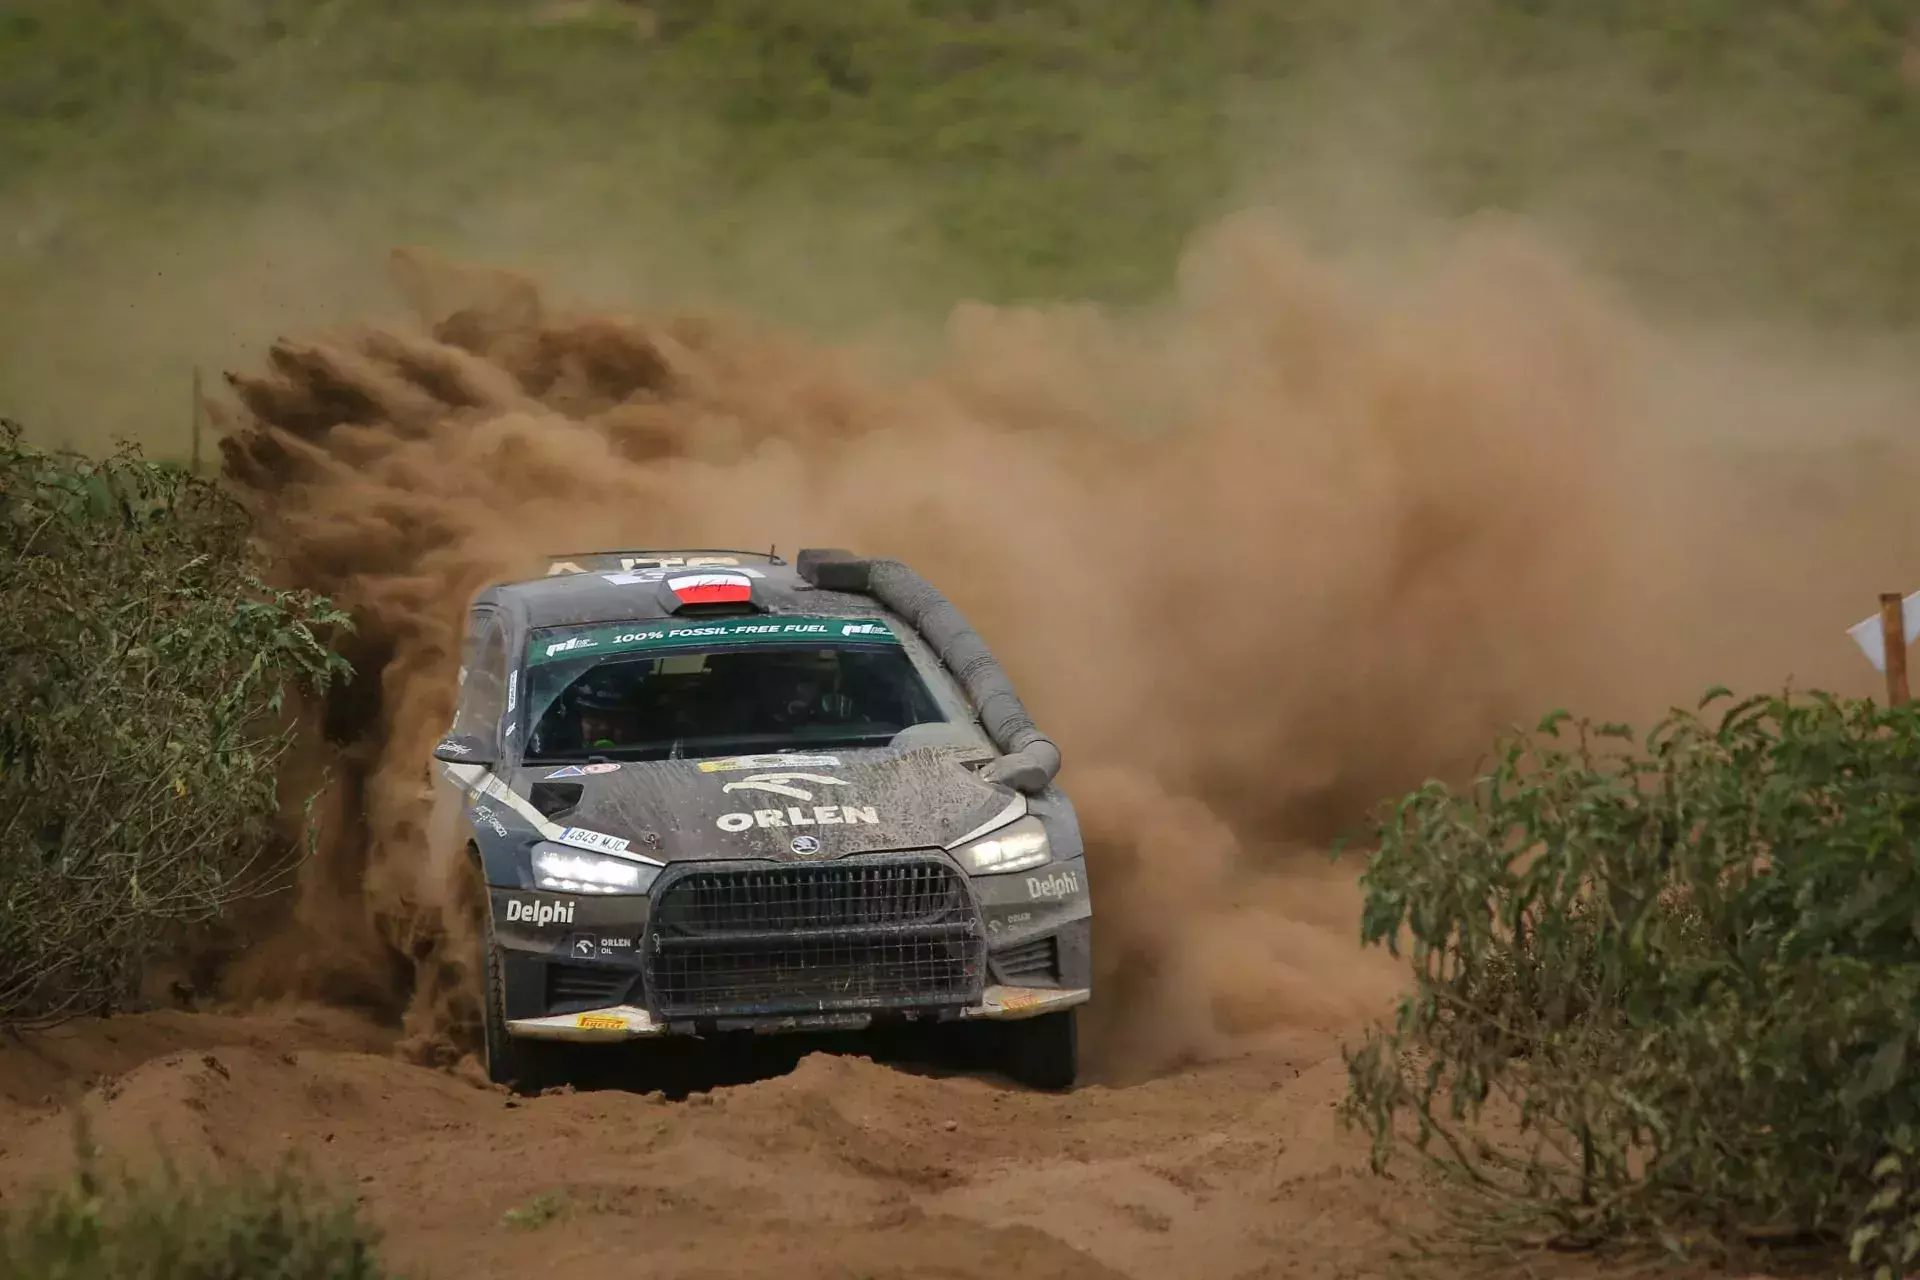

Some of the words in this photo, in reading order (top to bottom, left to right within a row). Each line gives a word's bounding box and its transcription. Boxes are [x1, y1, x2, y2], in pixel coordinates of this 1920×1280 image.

[612, 630, 664, 645] 100%
[668, 624, 780, 639] FOSSIL-FREE
[784, 624, 828, 634] FUEL
[716, 805, 880, 832] ORLEN
[569, 830, 599, 845] 4849
[601, 836, 625, 851] MJC
[1026, 871, 1080, 899] Delphi
[506, 900, 575, 927] Delphi
[600, 938, 631, 947] ORLEN
